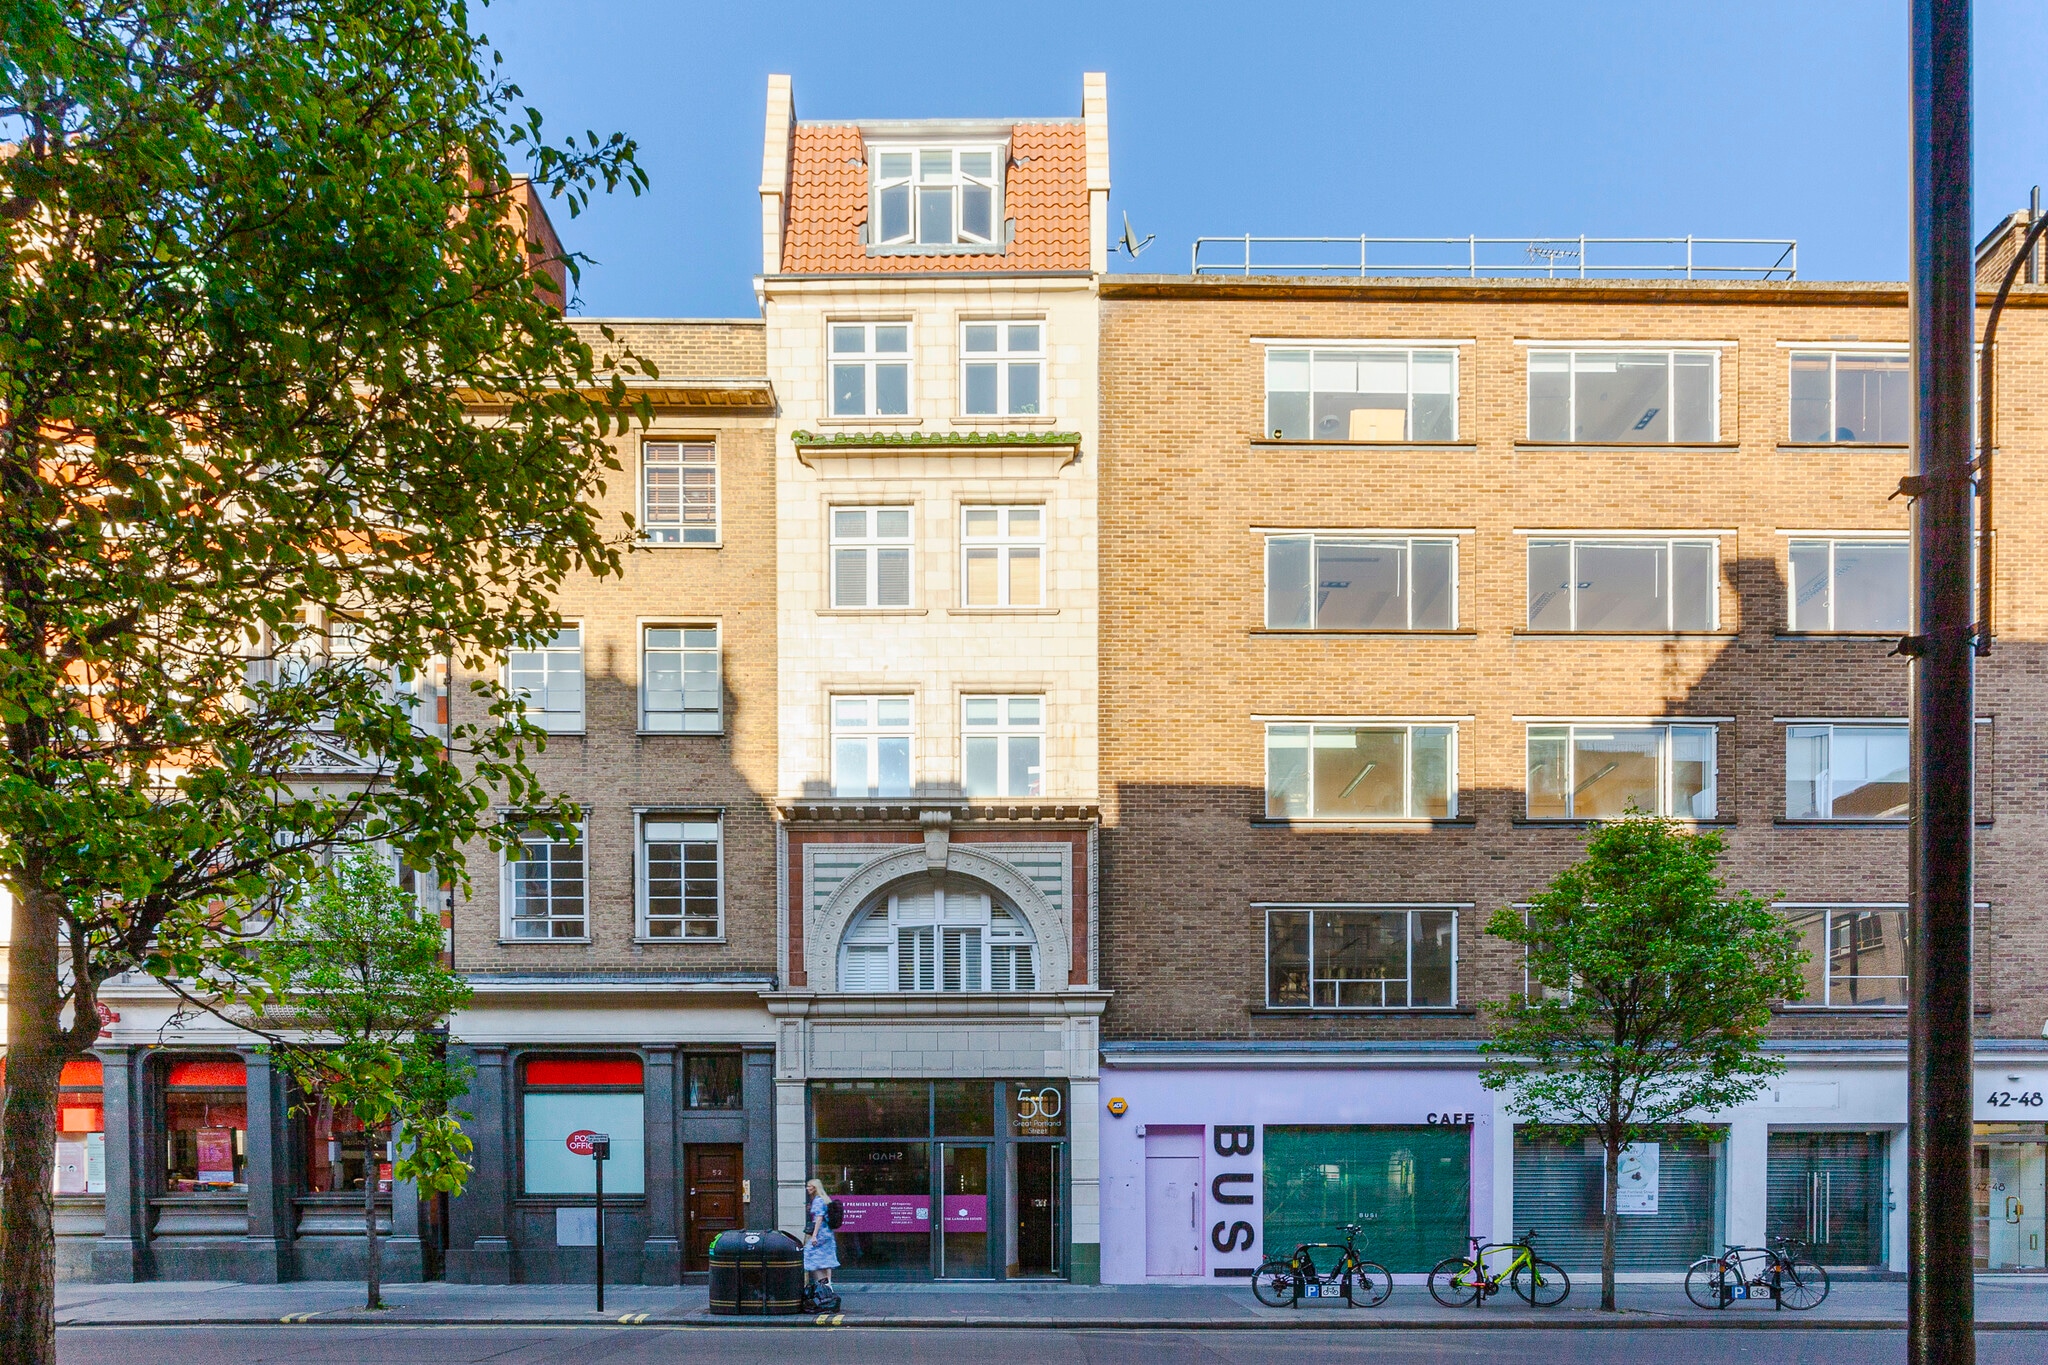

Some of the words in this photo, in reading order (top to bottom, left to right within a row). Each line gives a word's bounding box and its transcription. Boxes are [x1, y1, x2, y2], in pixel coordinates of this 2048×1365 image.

[1017, 1087, 1061, 1118] 50
[1987, 1092, 2044, 1107] 42-48
[1426, 1113, 1475, 1125] CAFE
[570, 1142, 594, 1150] OFFIC
[1975, 1183, 2006, 1192] 42-48
[1212, 1125, 1255, 1278] BUSI
[1308, 1286, 1317, 1297] P
[1734, 1286, 1744, 1299] P
